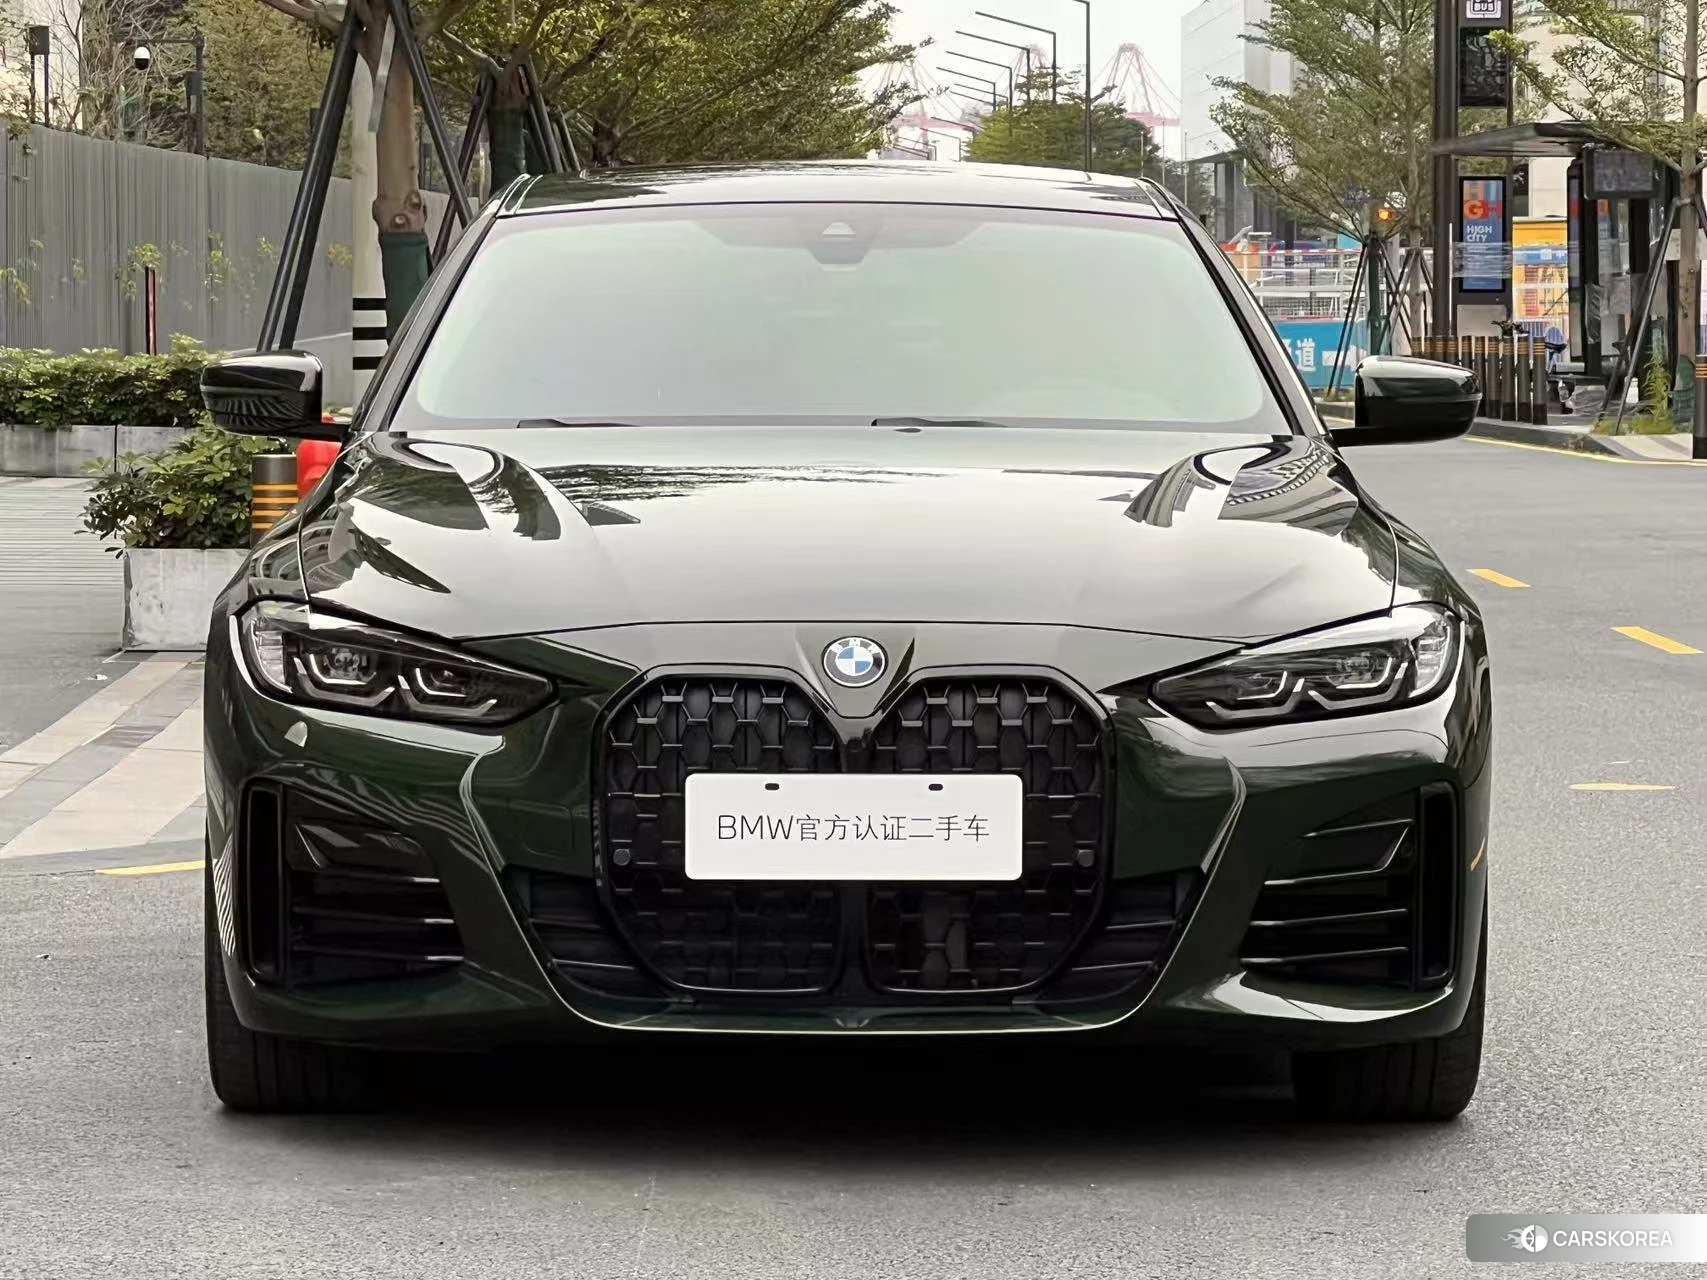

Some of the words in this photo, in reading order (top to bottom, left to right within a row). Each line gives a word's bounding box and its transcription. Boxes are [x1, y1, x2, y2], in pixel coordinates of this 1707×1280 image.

[1474, 2, 1494, 11] BUS
[1467, 225, 1492, 234] HIGH
[1467, 234, 1488, 242] CITY
[718, 813, 989, 842] BMW官方认证二手车
